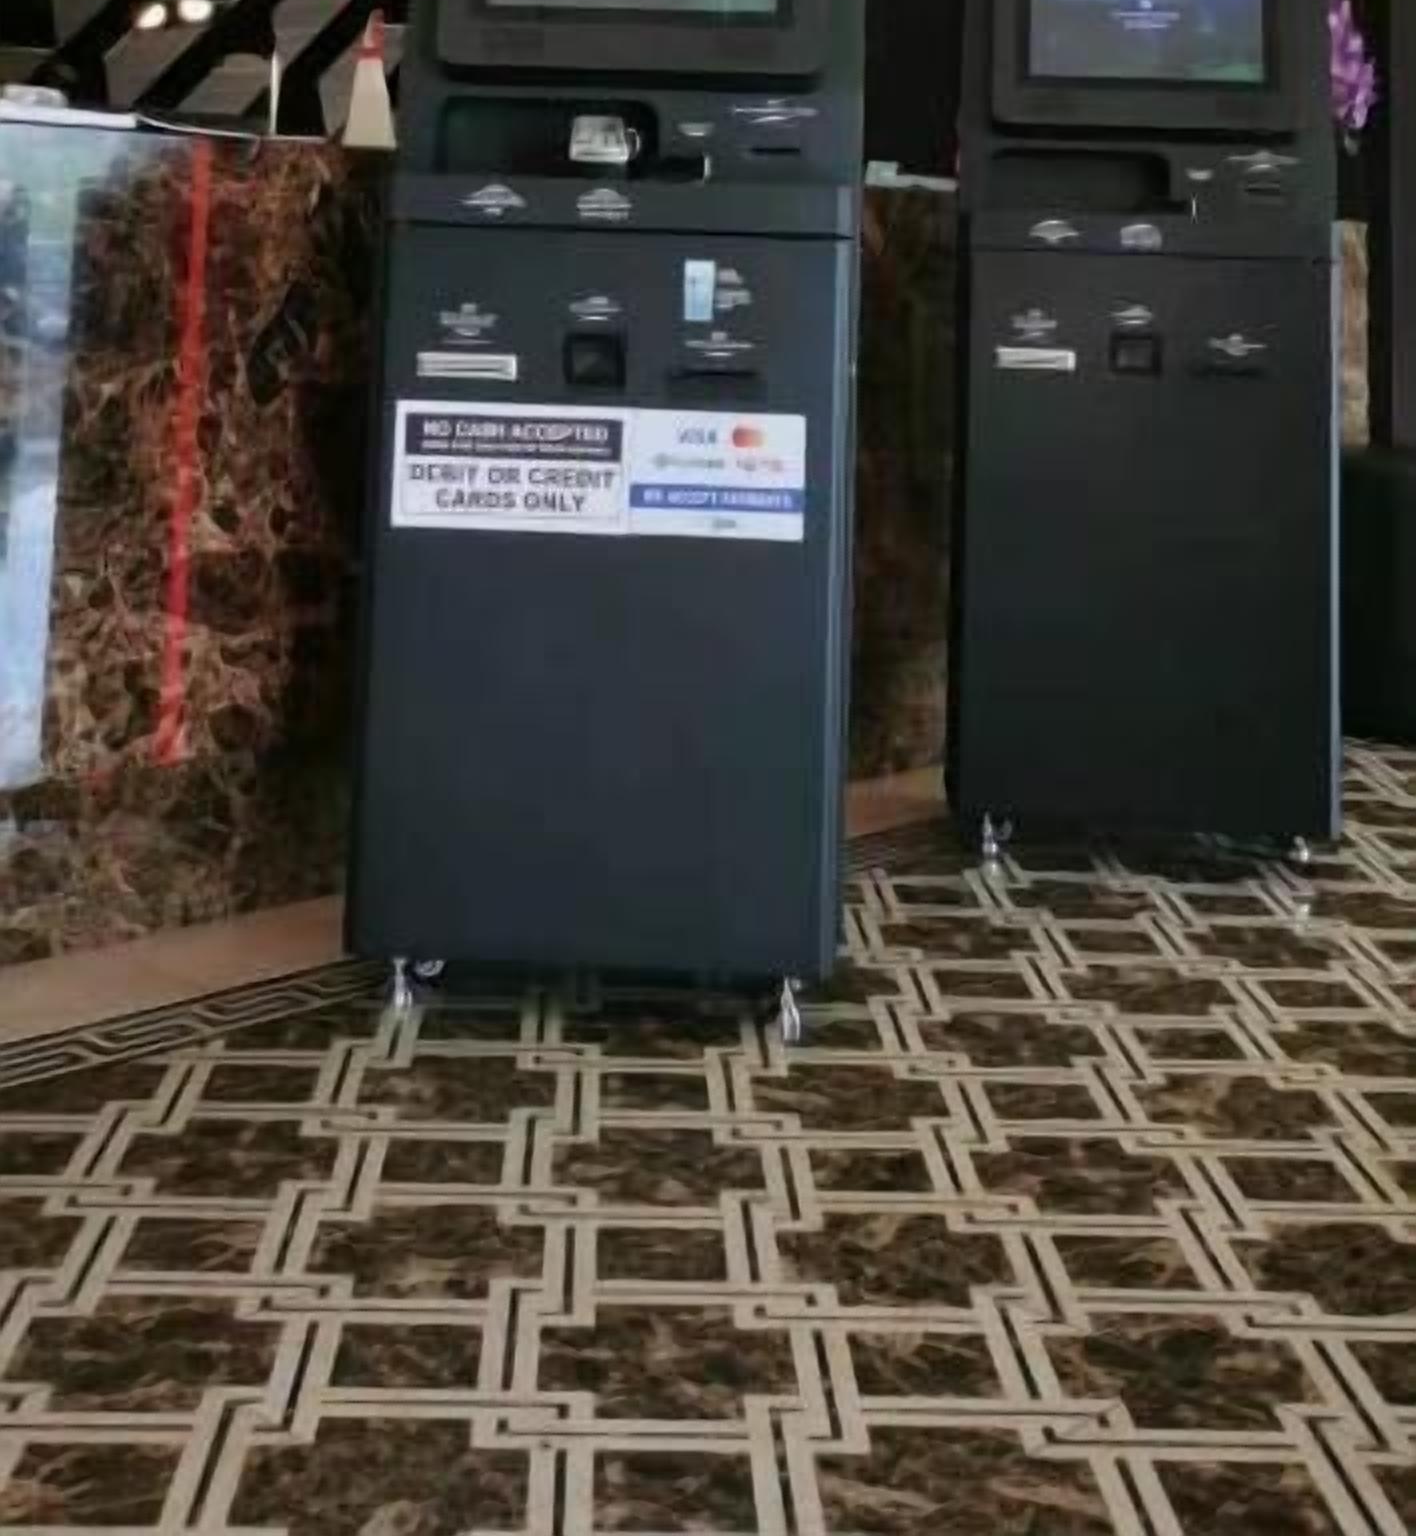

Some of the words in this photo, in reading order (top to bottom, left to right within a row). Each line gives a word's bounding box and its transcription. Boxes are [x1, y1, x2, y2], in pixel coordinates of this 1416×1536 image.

[423, 420, 452, 436] NO
[410, 463, 477, 485] DEBIT
[487, 466, 521, 484] OR
[527, 467, 617, 489] CREDIT
[435, 487, 516, 509] CARDS
[523, 490, 585, 513] ONLY
